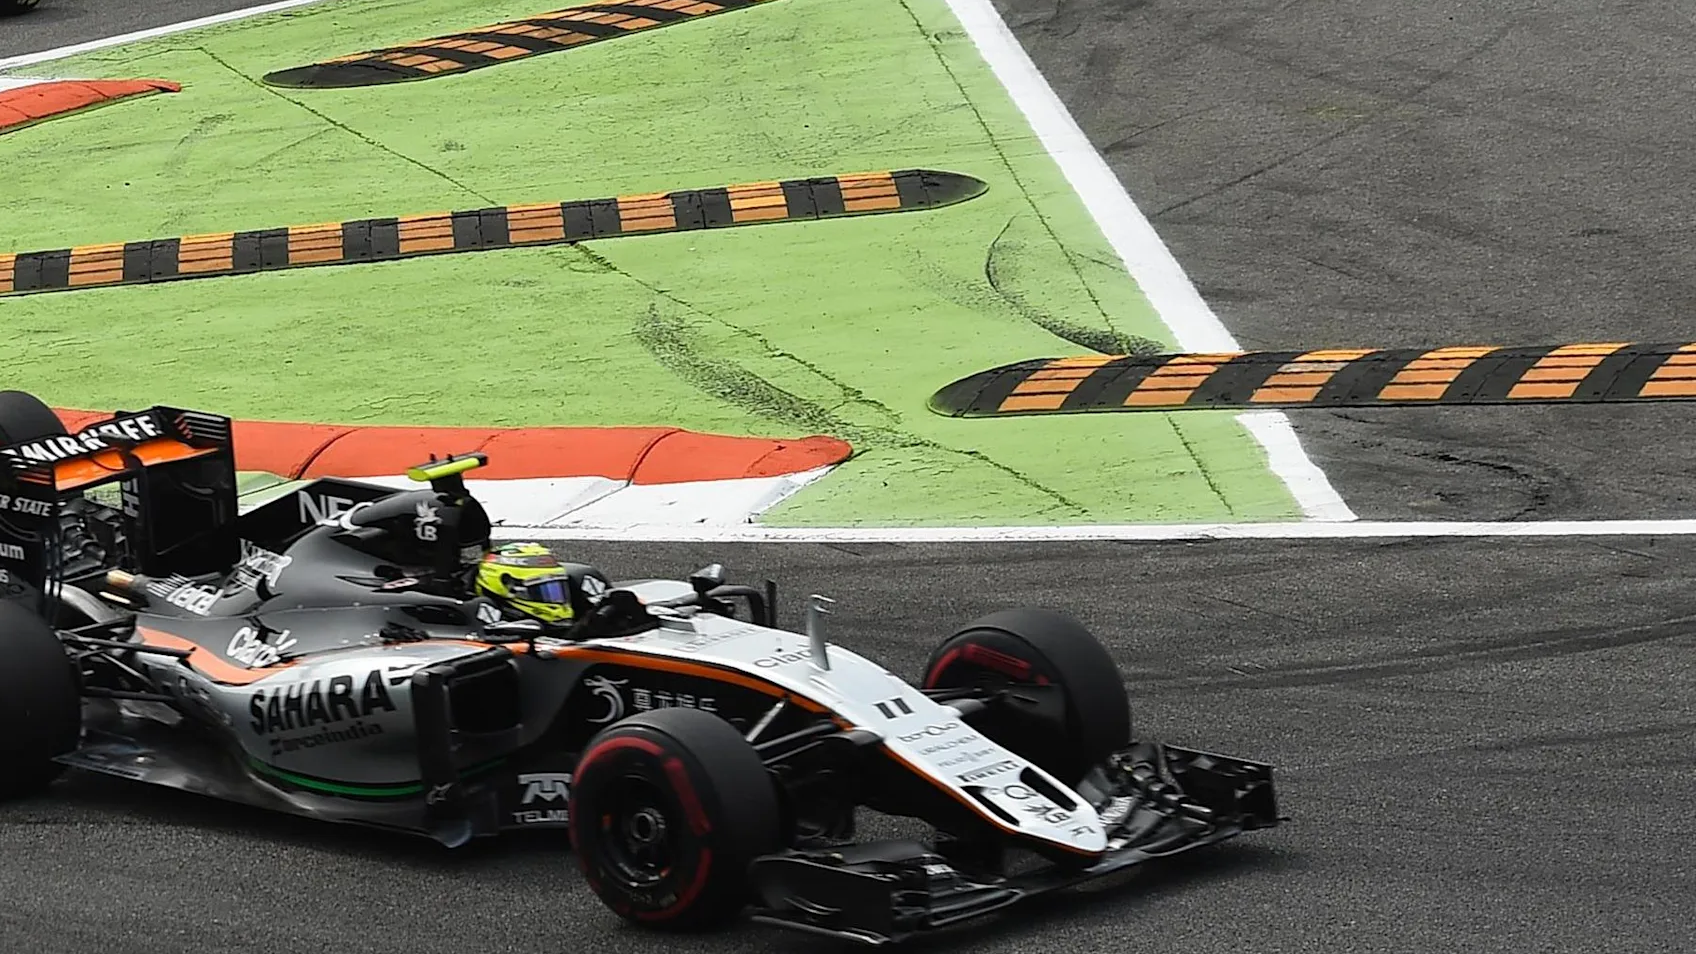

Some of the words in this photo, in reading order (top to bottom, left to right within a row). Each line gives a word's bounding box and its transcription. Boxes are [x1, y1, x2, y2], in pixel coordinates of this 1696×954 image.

[12, 496, 54, 517] STATE
[250, 668, 396, 736] SAHARA
[873, 697, 915, 720] 11
[955, 759, 1020, 783] PIRELLI
[512, 809, 570, 825] TELME
